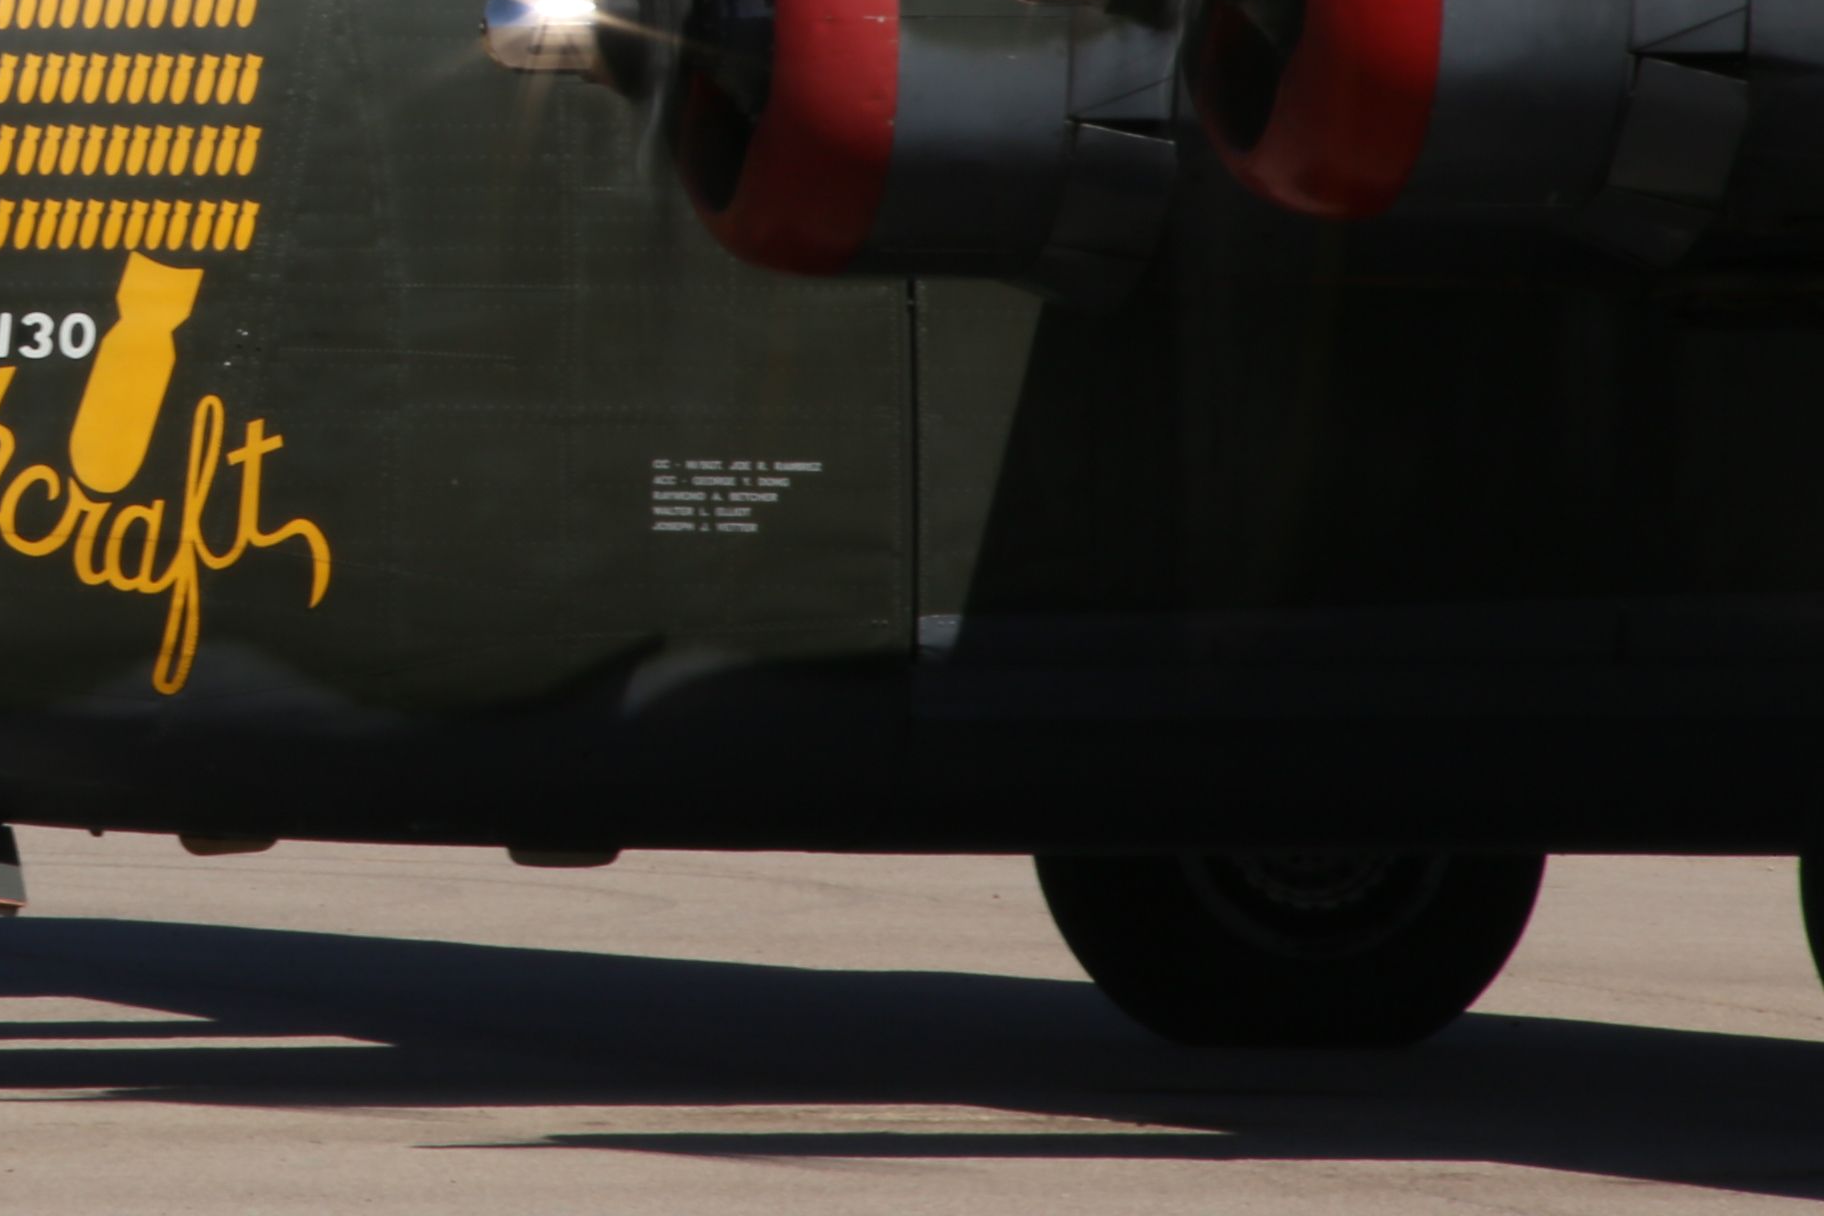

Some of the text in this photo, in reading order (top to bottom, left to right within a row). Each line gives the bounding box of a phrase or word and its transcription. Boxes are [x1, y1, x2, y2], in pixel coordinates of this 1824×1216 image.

[729, 460, 752, 471] JOE
[691, 475, 736, 487] GEORGE
[652, 490, 707, 501] RAYMOND
[652, 505, 695, 516] WALTER
[651, 521, 696, 532] JOSEPH
